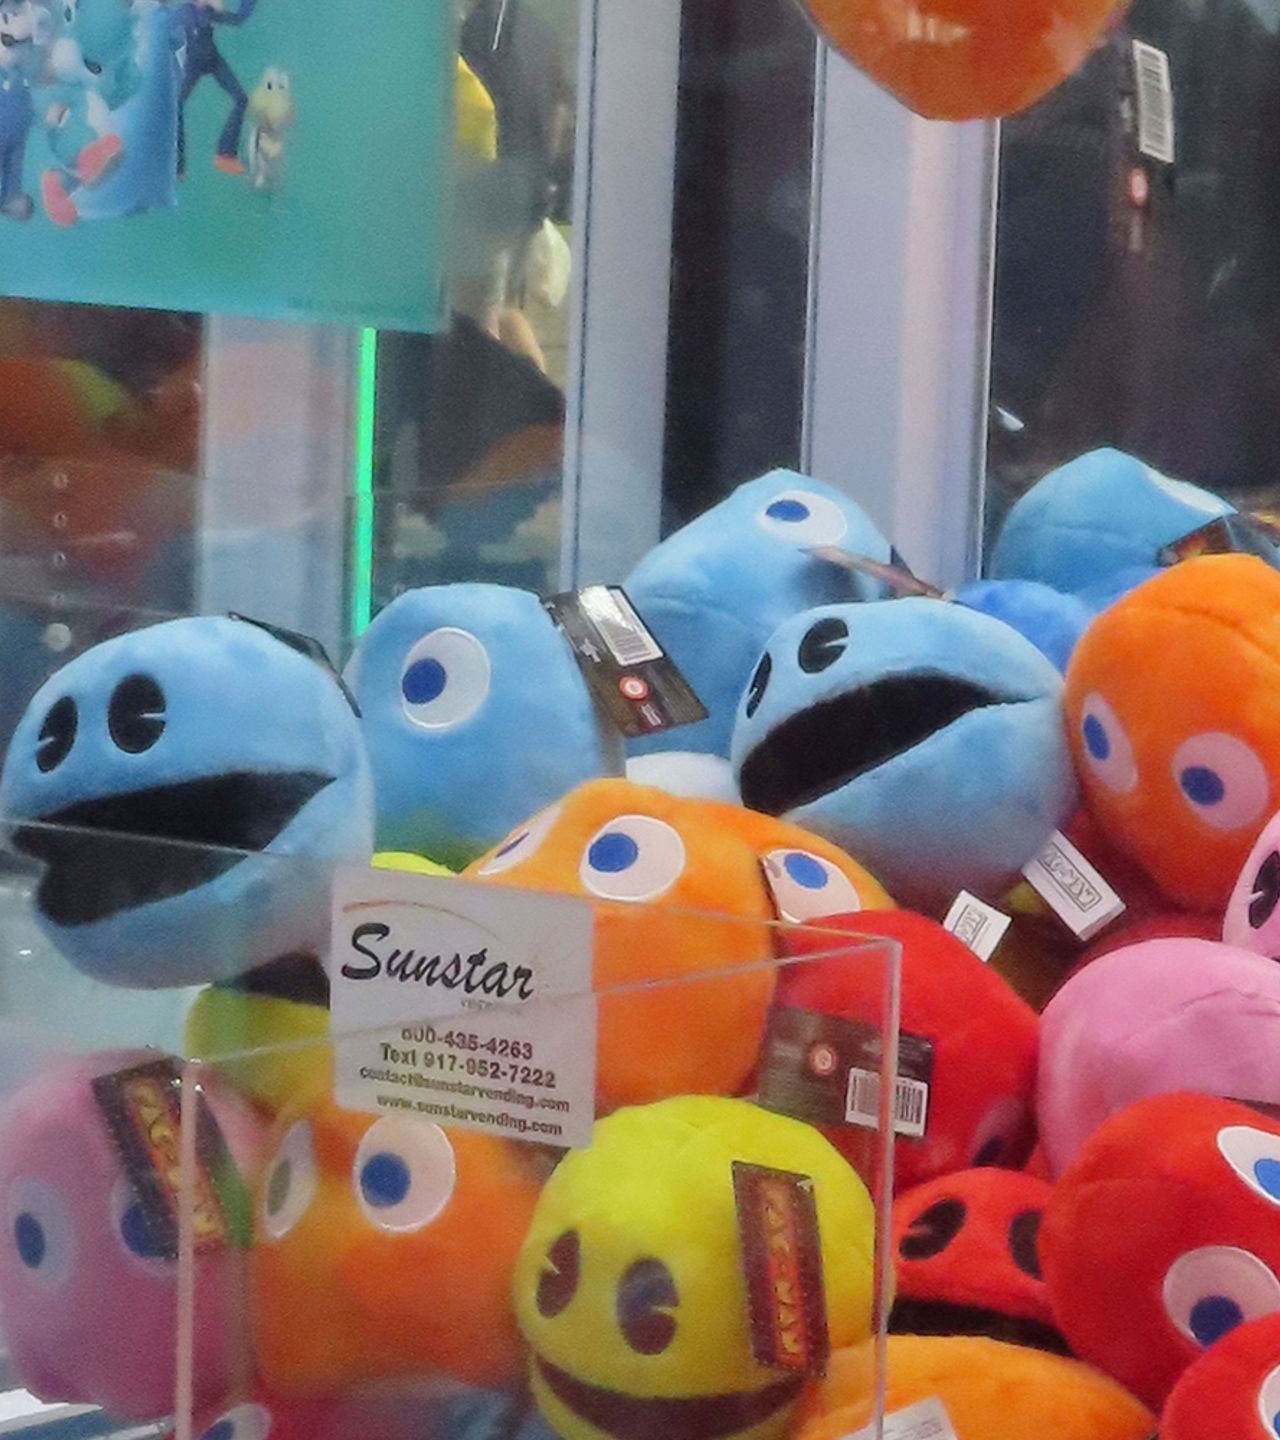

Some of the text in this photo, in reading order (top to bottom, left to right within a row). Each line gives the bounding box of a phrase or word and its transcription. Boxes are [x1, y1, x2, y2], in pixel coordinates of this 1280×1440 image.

[341, 922, 534, 1000] Sunstar
[380, 1043, 556, 1088] Text 917-952-7222
[377, 1095, 563, 1136] www.sunstarvending.com
